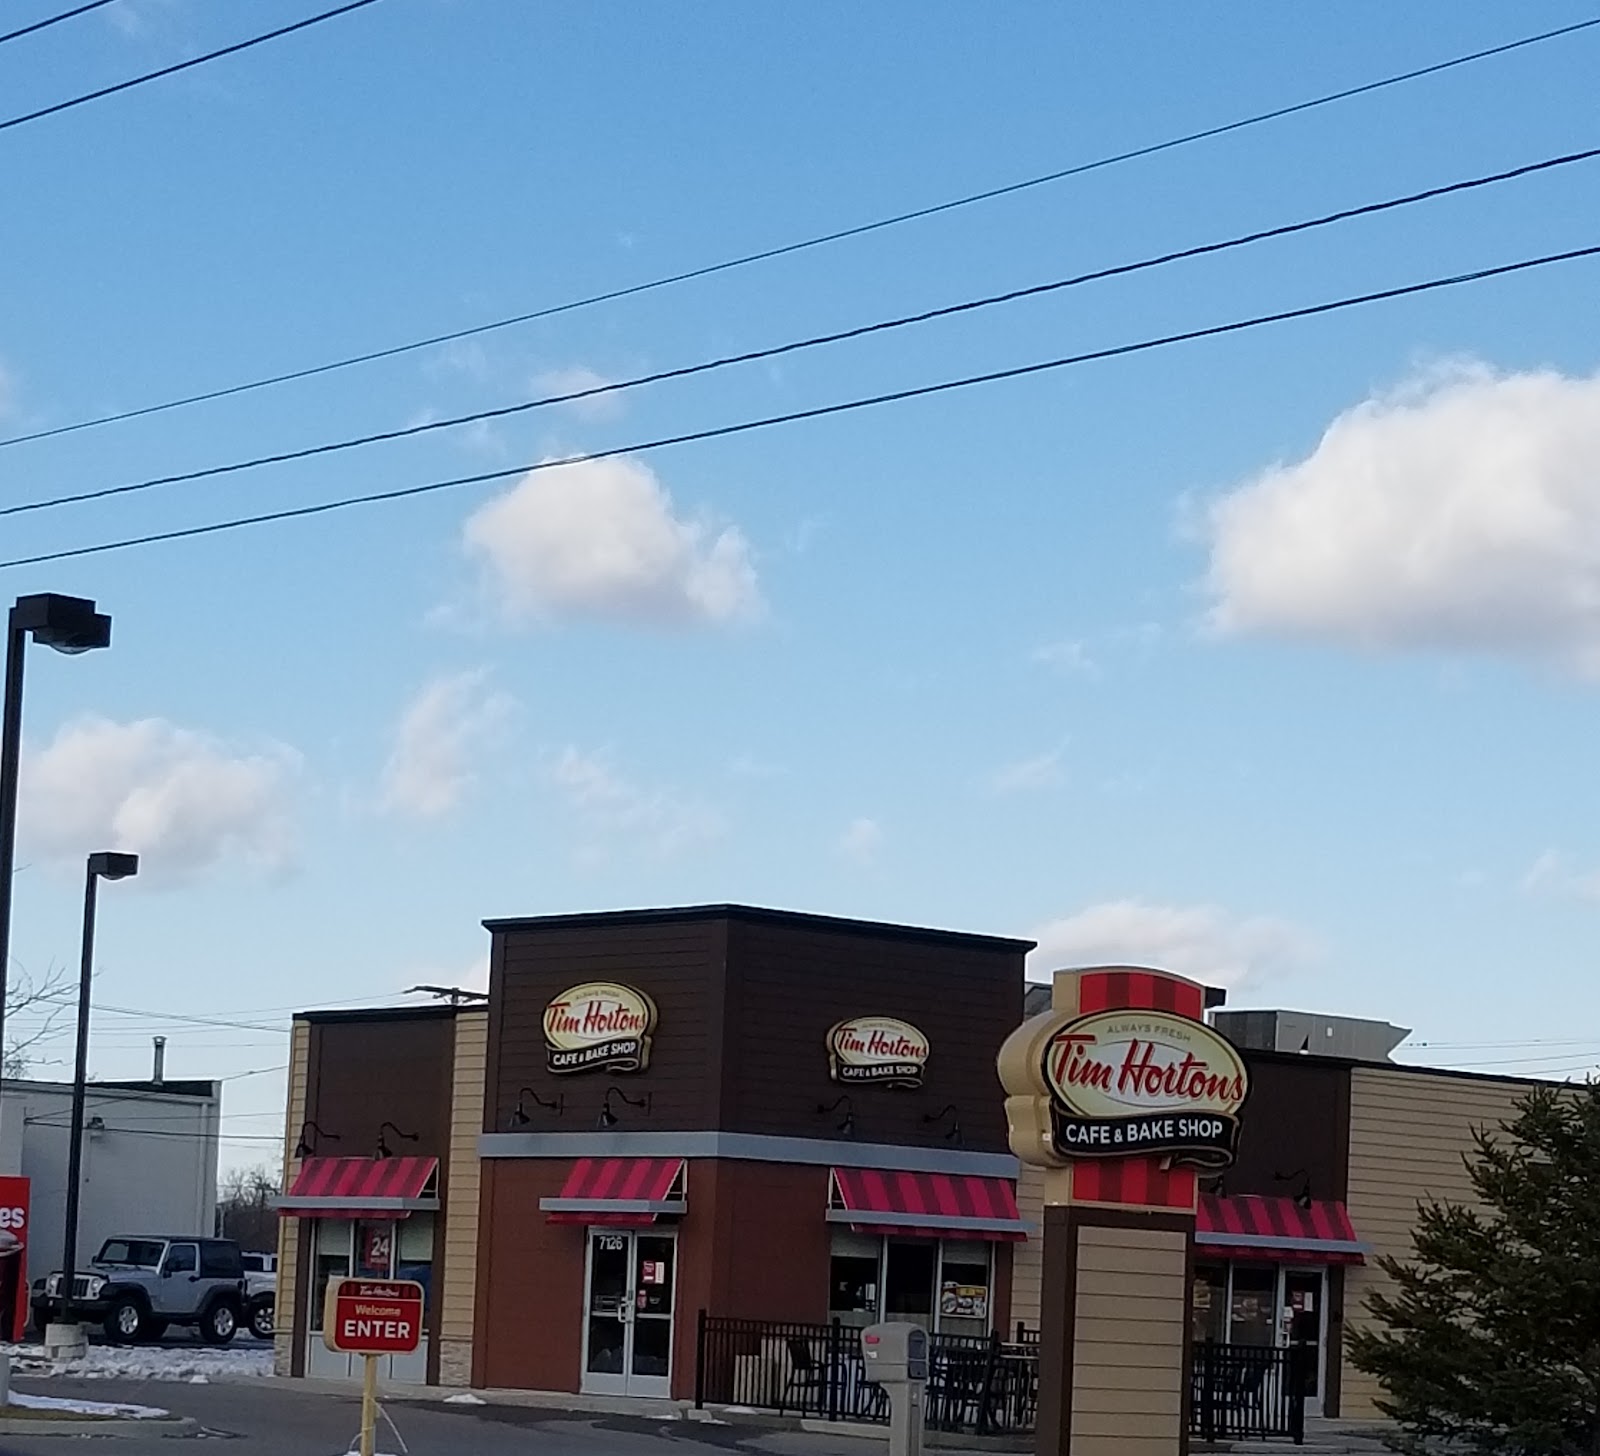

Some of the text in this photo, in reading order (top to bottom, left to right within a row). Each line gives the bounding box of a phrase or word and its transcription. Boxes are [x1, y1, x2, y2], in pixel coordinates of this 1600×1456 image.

[547, 1000, 645, 1033] Tim Hortons
[838, 1027, 926, 1058] Tim Hortons
[1107, 1024, 1191, 1042] ALWAYS FRESH
[553, 1053, 578, 1065] CAFE
[585, 1044, 609, 1061] BAKE
[610, 1042, 636, 1055] SHOP
[842, 1067, 864, 1077] CAFE
[871, 1065, 894, 1076] BAKE
[896, 1065, 918, 1074] SHOP
[1055, 1034, 1243, 1101] Tim Hortons
[1066, 1119, 1223, 1144] CAFE & BAKE SHOP
[371, 1237, 390, 1256] 24
[600, 1236, 623, 1250] 7126
[355, 1304, 402, 1317] Welcome
[344, 1319, 411, 1339] ENTER
